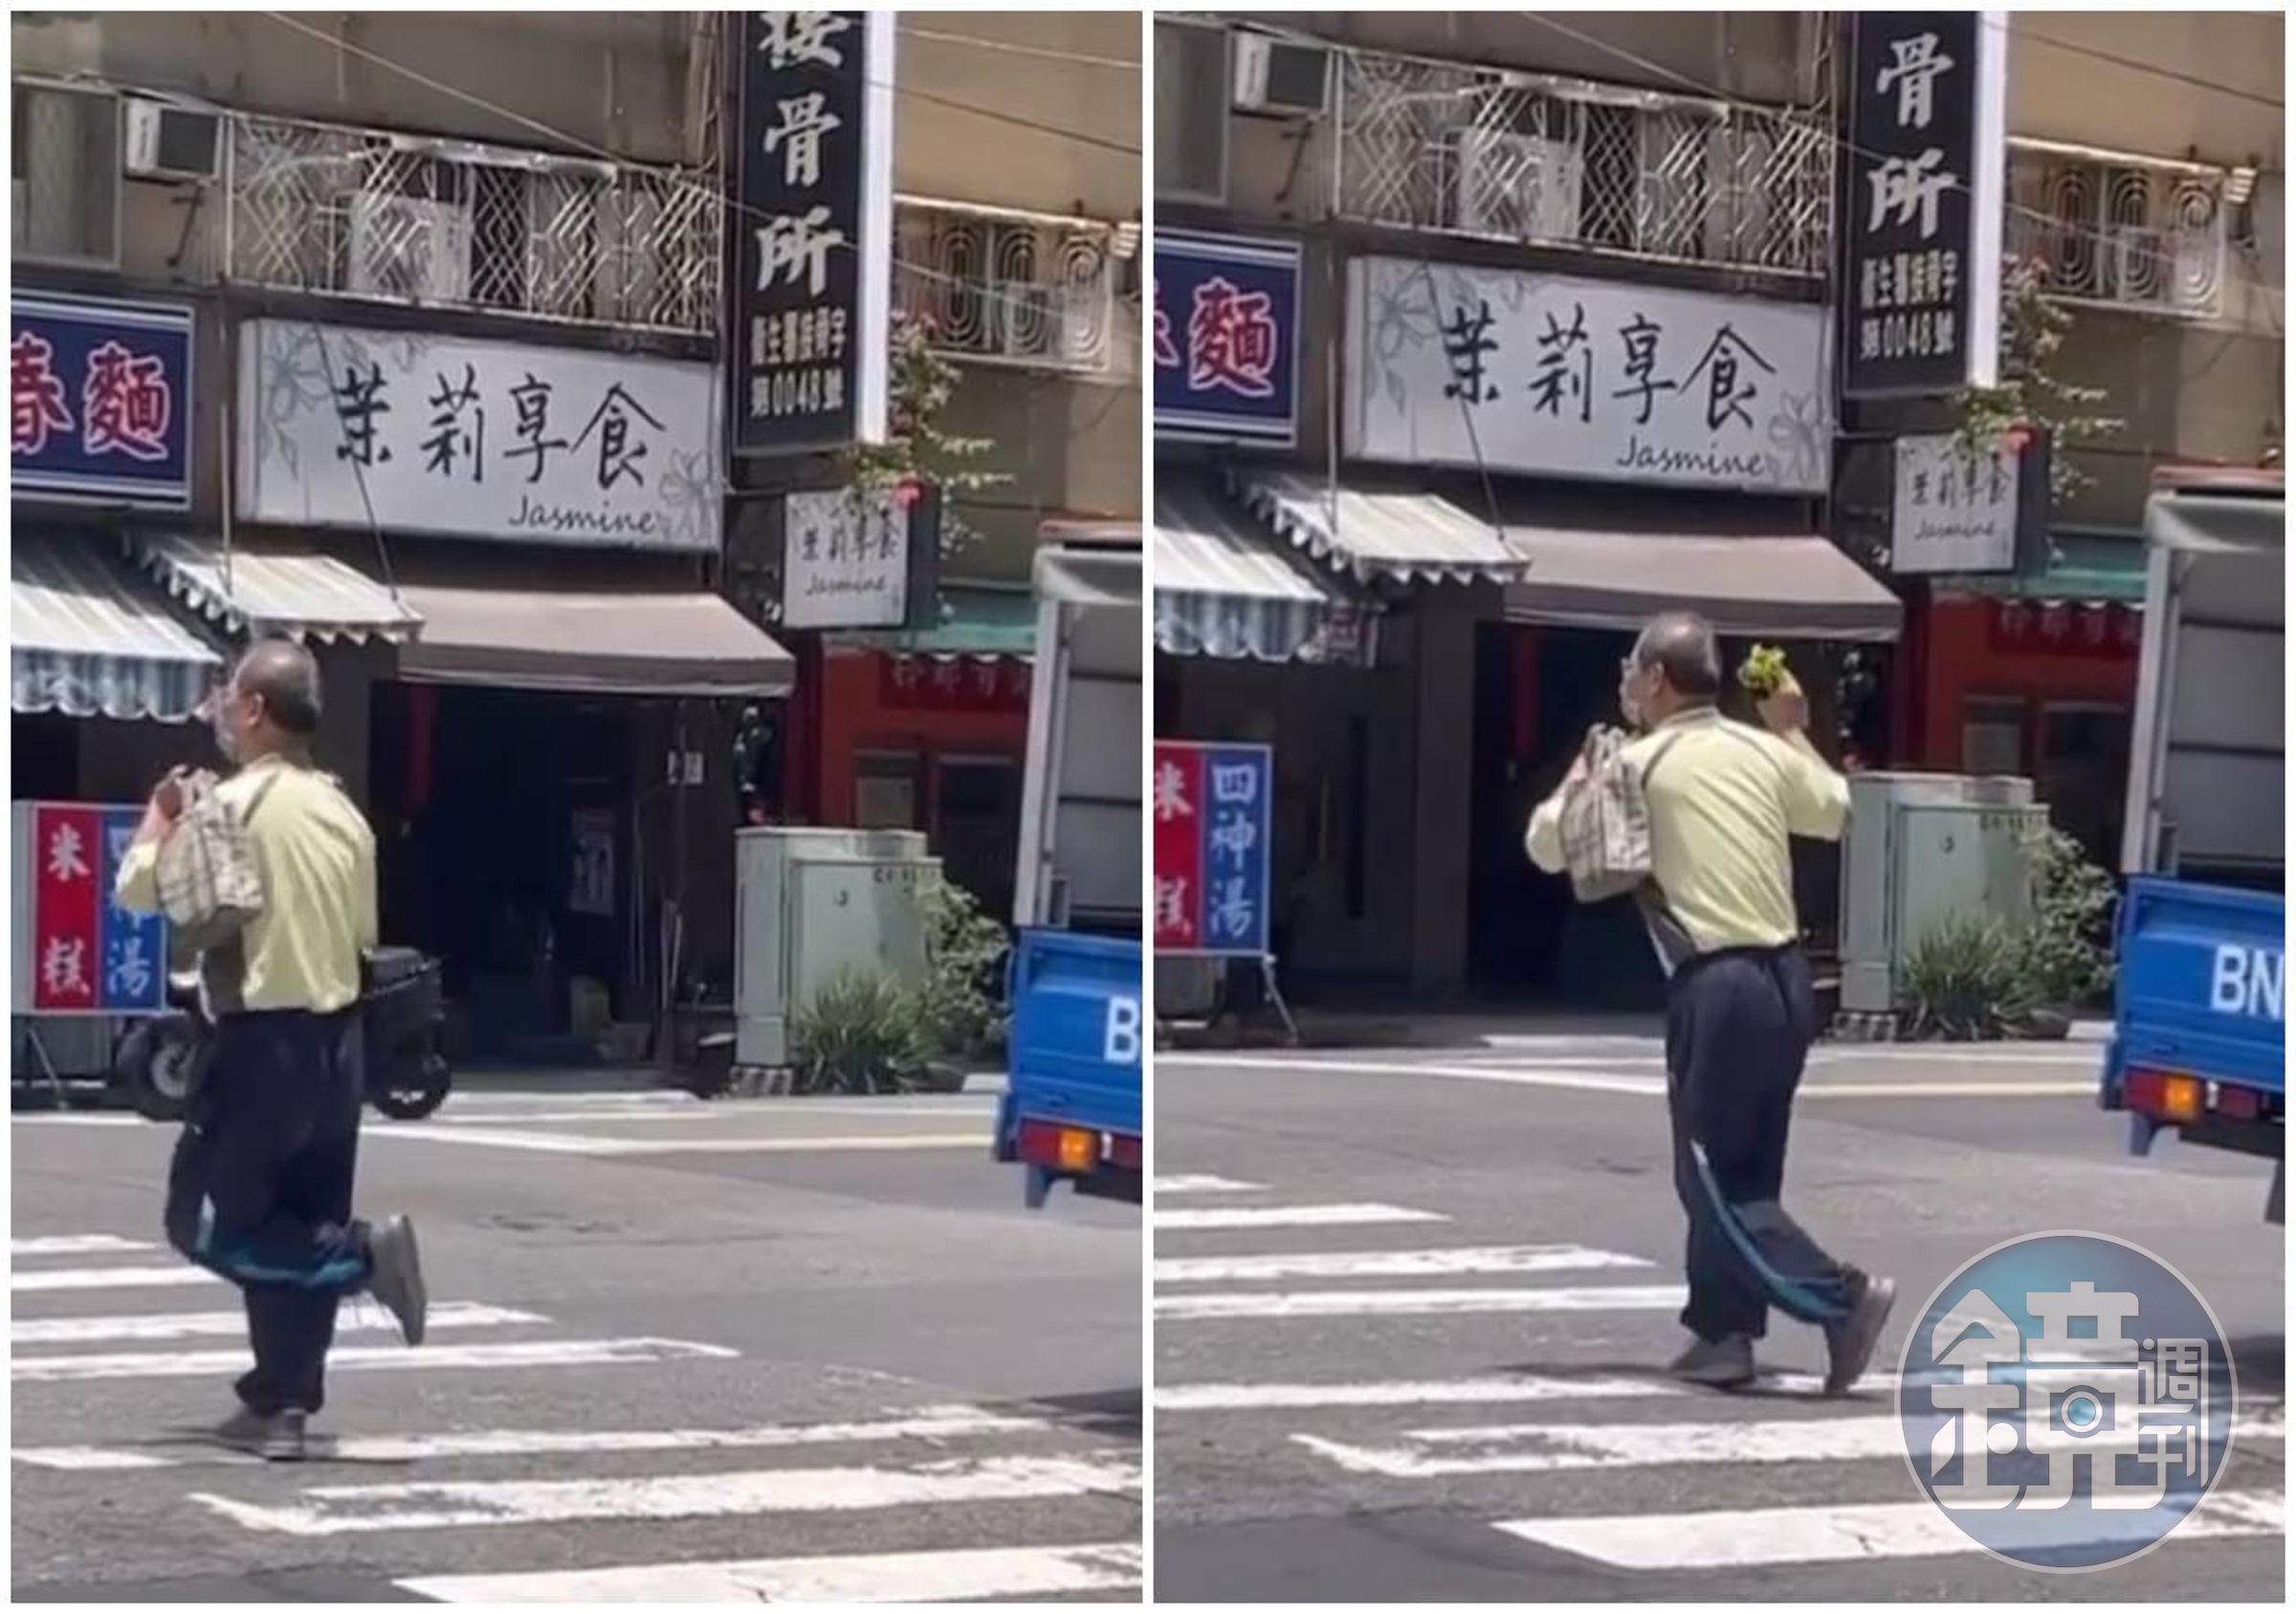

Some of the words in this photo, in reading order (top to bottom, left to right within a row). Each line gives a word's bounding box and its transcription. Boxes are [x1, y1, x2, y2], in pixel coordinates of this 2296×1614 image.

[1866, 33, 1955, 238] 骨所
[11, 331, 170, 461] 春麵
[336, 361, 667, 488] 茉莉享食
[1443, 299, 1777, 431] 茉莉享食
[509, 495, 656, 538] Jasmine
[1616, 435, 1763, 477] Jasmine
[43, 822, 91, 995] 米糕
[1210, 763, 1257, 938] 四神湯
[1104, 996, 1141, 1065] B
